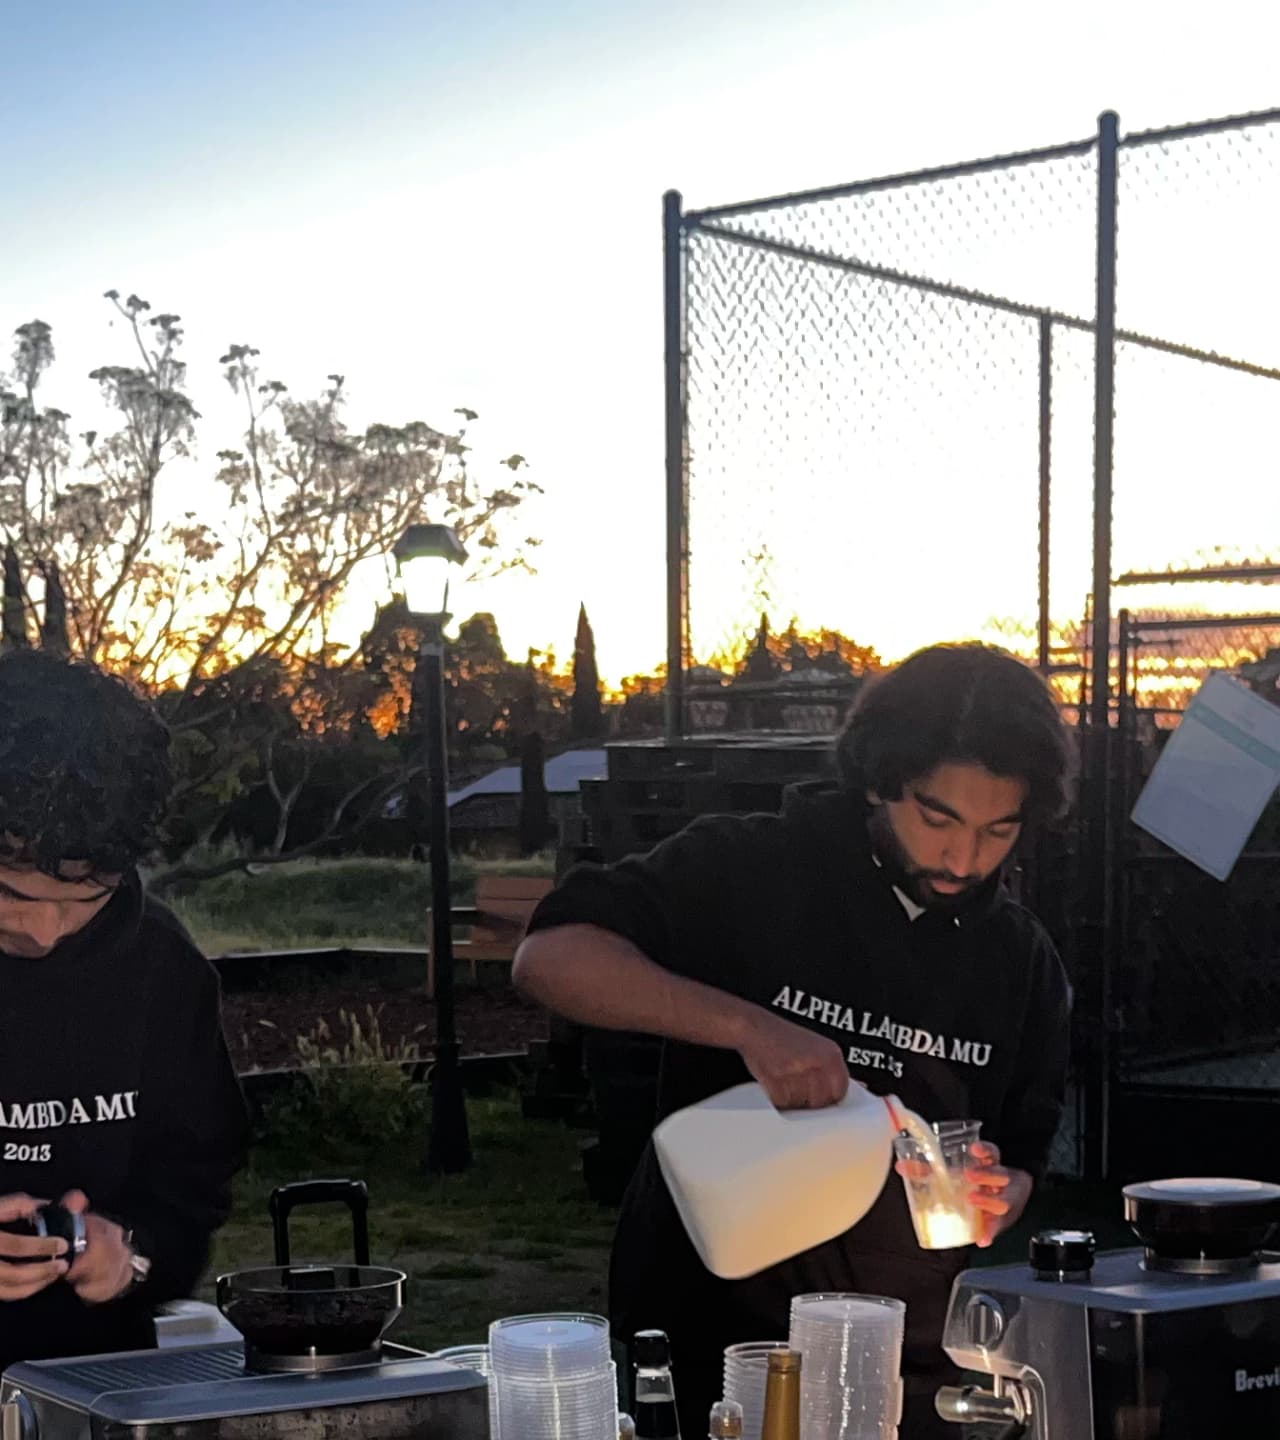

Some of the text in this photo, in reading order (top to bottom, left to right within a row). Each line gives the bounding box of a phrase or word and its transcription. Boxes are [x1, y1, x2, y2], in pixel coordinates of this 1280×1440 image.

[772, 985, 855, 1032] ALPHA
[950, 1038, 992, 1066] MU
[847, 1046, 886, 1070] EST.
[3, 1142, 52, 1162] 2013
